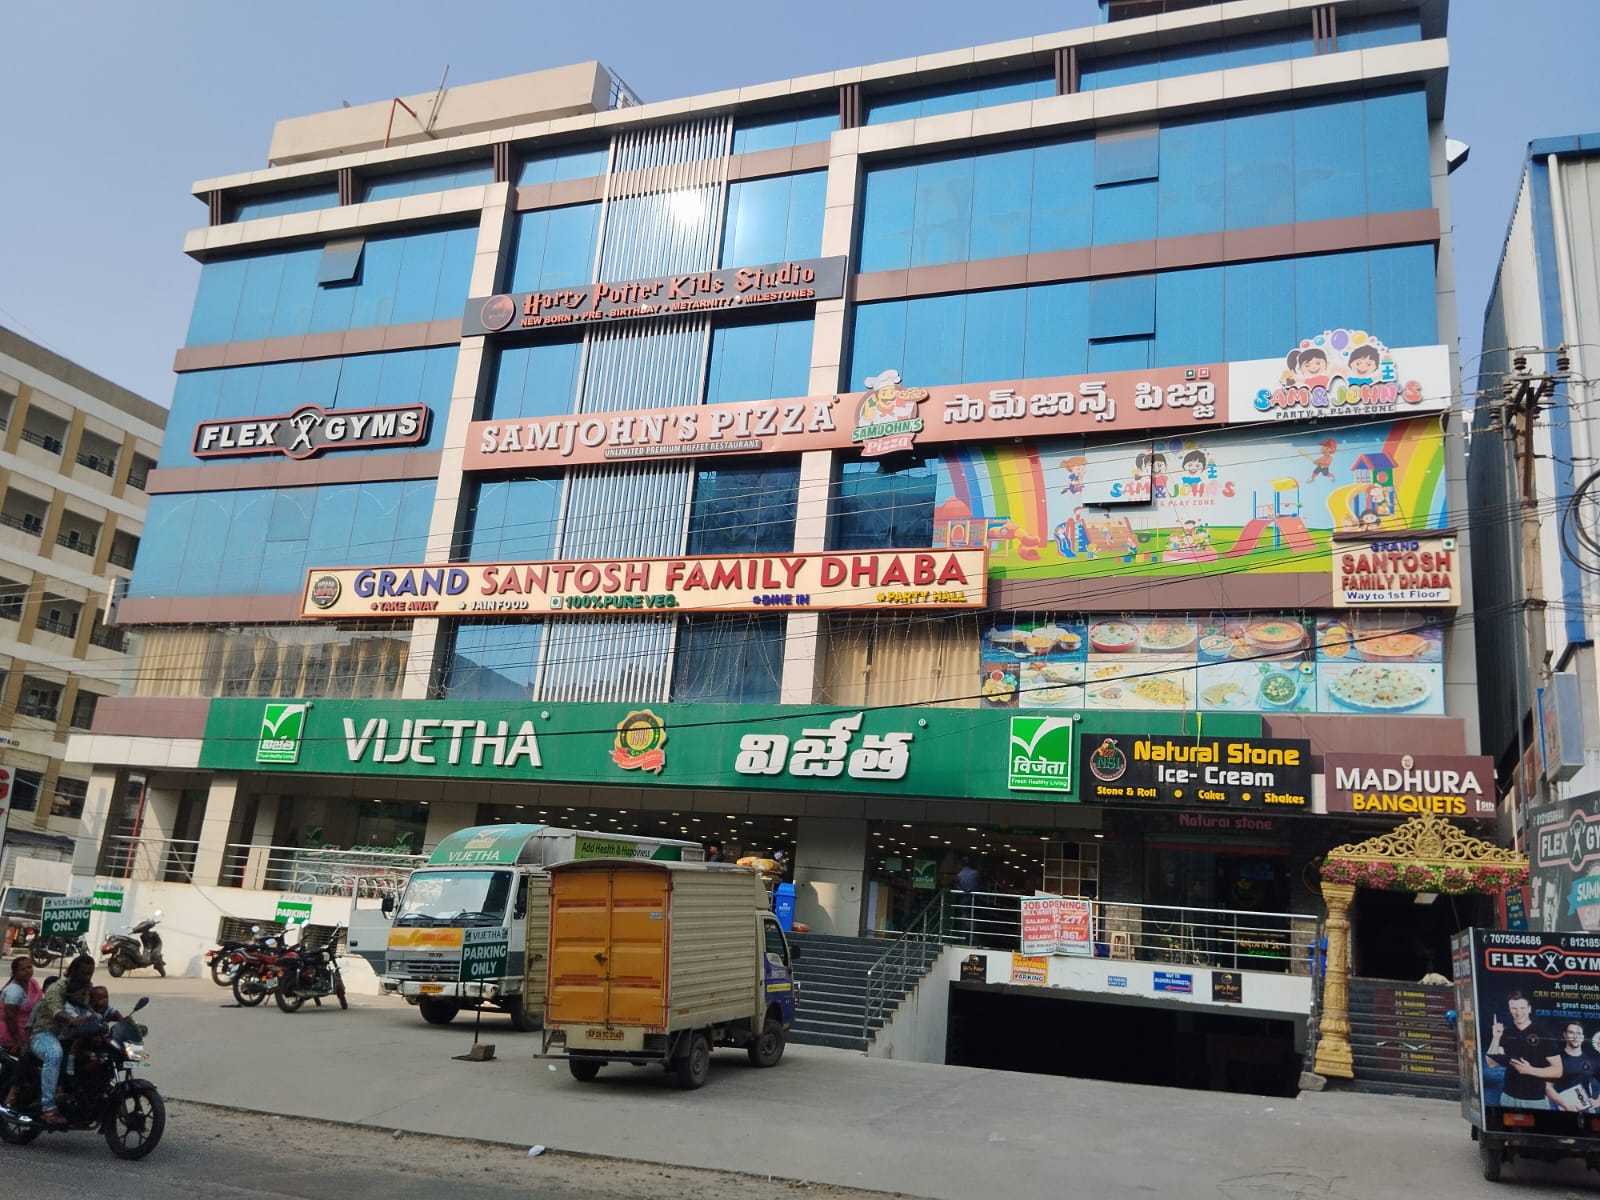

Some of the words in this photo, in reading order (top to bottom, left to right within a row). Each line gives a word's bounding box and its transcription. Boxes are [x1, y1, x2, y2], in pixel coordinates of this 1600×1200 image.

[522, 290, 587, 316] Harry
[592, 279, 664, 311] Potter
[668, 272, 724, 299] Kids
[734, 262, 815, 292] Studio
[520, 317, 542, 327] NEW
[544, 314, 571, 325] BORN
[582, 311, 602, 321] PRE
[610, 305, 661, 317] BIRTHDAY
[672, 297, 735, 312] METARNITY
[745, 288, 815, 303] MILESTONES
[1254, 386, 1309, 412] SAM
[1312, 385, 1329, 408] &
[1276, 409, 1314, 420] PARTY
[1330, 405, 1360, 416] PLAY
[1362, 403, 1396, 413] ZONE
[202, 422, 280, 449] FLEX
[325, 411, 418, 441] GYMS
[481, 411, 698, 457] SAMJOHN'S
[709, 400, 837, 439] PIZZA
[852, 418, 923, 441] SAMJOHN'S
[606, 447, 645, 457] UNLIMITED
[645, 444, 682, 455] PREMIUM
[710, 440, 760, 450] RESTAURANT
[1110, 482, 1151, 498] SAM
[1155, 485, 1167, 498] &
[1169, 481, 1236, 498] JOHNS
[1370, 540, 1420, 552] GRAND
[1342, 551, 1452, 574] SANTOSH
[354, 567, 469, 598] GRAND
[481, 561, 650, 595] SANTOSH
[665, 557, 806, 590] FAMILY
[821, 553, 968, 587] DHABA
[1342, 575, 1395, 591] FAMILY
[1399, 574, 1452, 589] DHABA
[762, 594, 793, 606] DINE
[795, 593, 810, 606] IN
[887, 591, 930, 604] PARTY
[933, 590, 968, 603] HALL
[1347, 591, 1371, 601] Way
[1373, 592, 1385, 600] to
[1388, 591, 1405, 599] 1st
[1409, 590, 1441, 600] Floor
[378, 602, 406, 612] TAKE
[408, 601, 439, 611] AWAY
[498, 600, 529, 611] FOOD
[343, 718, 543, 768] VIJETHA
[735, 711, 914, 780] విజేత
[1134, 740, 1219, 763] Natural
[1227, 743, 1300, 766] Stone
[1013, 755, 1067, 775] विजेता
[1204, 766, 1275, 787] Cream
[1335, 767, 1483, 795] MADHURA
[1096, 786, 1124, 796] Stone
[1126, 787, 1134, 796] &
[1137, 787, 1157, 798] Roll
[1198, 790, 1226, 801] Cakes
[1264, 793, 1305, 804] Shakes
[1352, 793, 1467, 815] BANQUETS
[1178, 813, 1231, 828] Natural
[1235, 817, 1273, 830] stone
[582, 842, 595, 853] Add
[596, 843, 615, 854] Health
[622, 847, 650, 859] Happiness
[1541, 832, 1568, 858] FLEX
[448, 850, 500, 862] VIJETHA
[1023, 901, 1041, 910] JOB
[1042, 900, 1087, 910] OPENINGS
[44, 910, 90, 921] PARKING
[52, 921, 80, 932] ONLY
[472, 930, 501, 940] VIJETHA
[1570, 937, 1600, 947] 812185
[463, 945, 506, 961] PARKING
[1491, 953, 1538, 968] FLEX
[470, 961, 497, 976] ONLY
[1014, 974, 1043, 982] PARKING
[1562, 983, 1578, 991] good
